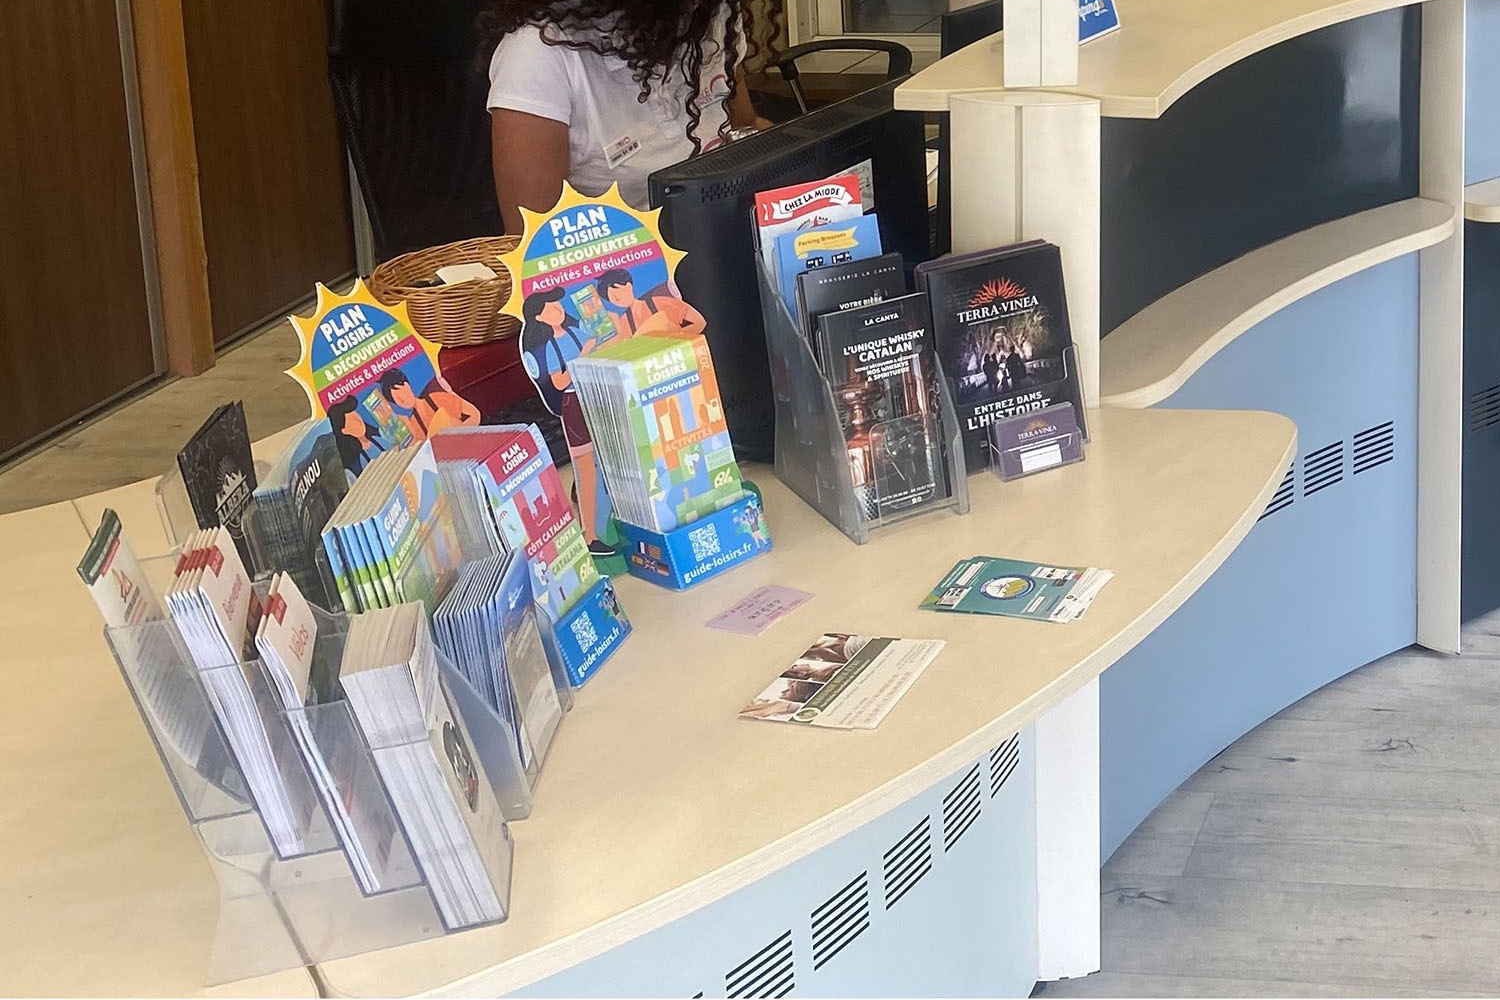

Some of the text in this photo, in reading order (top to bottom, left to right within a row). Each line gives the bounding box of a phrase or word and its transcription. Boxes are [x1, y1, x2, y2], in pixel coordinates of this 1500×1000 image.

[783, 186, 841, 212] CHEZ LA MIODE
[549, 206, 607, 237] PLAN
[554, 223, 611, 250] LOISIRS
[537, 232, 638, 273] & DÉCOUVERTES
[532, 247, 653, 292] Activités & Réductions
[818, 265, 897, 285] BRASSERIE LA CANYA
[839, 299, 862, 310] VOTRE
[320, 304, 367, 343] PLAN
[864, 312, 900, 326] LA CANYA
[329, 321, 375, 357] LOISIRS
[843, 328, 926, 357] L'UNIQUE WHISKY
[858, 340, 913, 363] CATALAN
[324, 329, 399, 382] & DÉCOUVERTES
[644, 348, 685, 374] PLAN
[866, 360, 910, 376] NOS WHISKYS
[326, 342, 415, 404] Activités & Réductions
[646, 362, 688, 385] LOISIRS
[873, 366, 911, 381] SPIRITUEUX
[641, 373, 700, 402] & DÉCOUVERTES
[967, 397, 1052, 431] L'HISTOIRE
[974, 390, 1044, 416] ENTREZ DANS
[501, 442, 521, 463] PLAN
[663, 426, 714, 452] ACTIVITÉS
[502, 448, 530, 475] LOISIRS
[506, 457, 544, 495] DÉCOUVERTES
[526, 512, 573, 557] CÔTE CATALANE
[554, 528, 576, 550] COSTA
[550, 543, 585, 577] CATALANA
[683, 541, 753, 584] guide-loisirs.fr
[576, 625, 622, 678] guide-loisirs.fr
